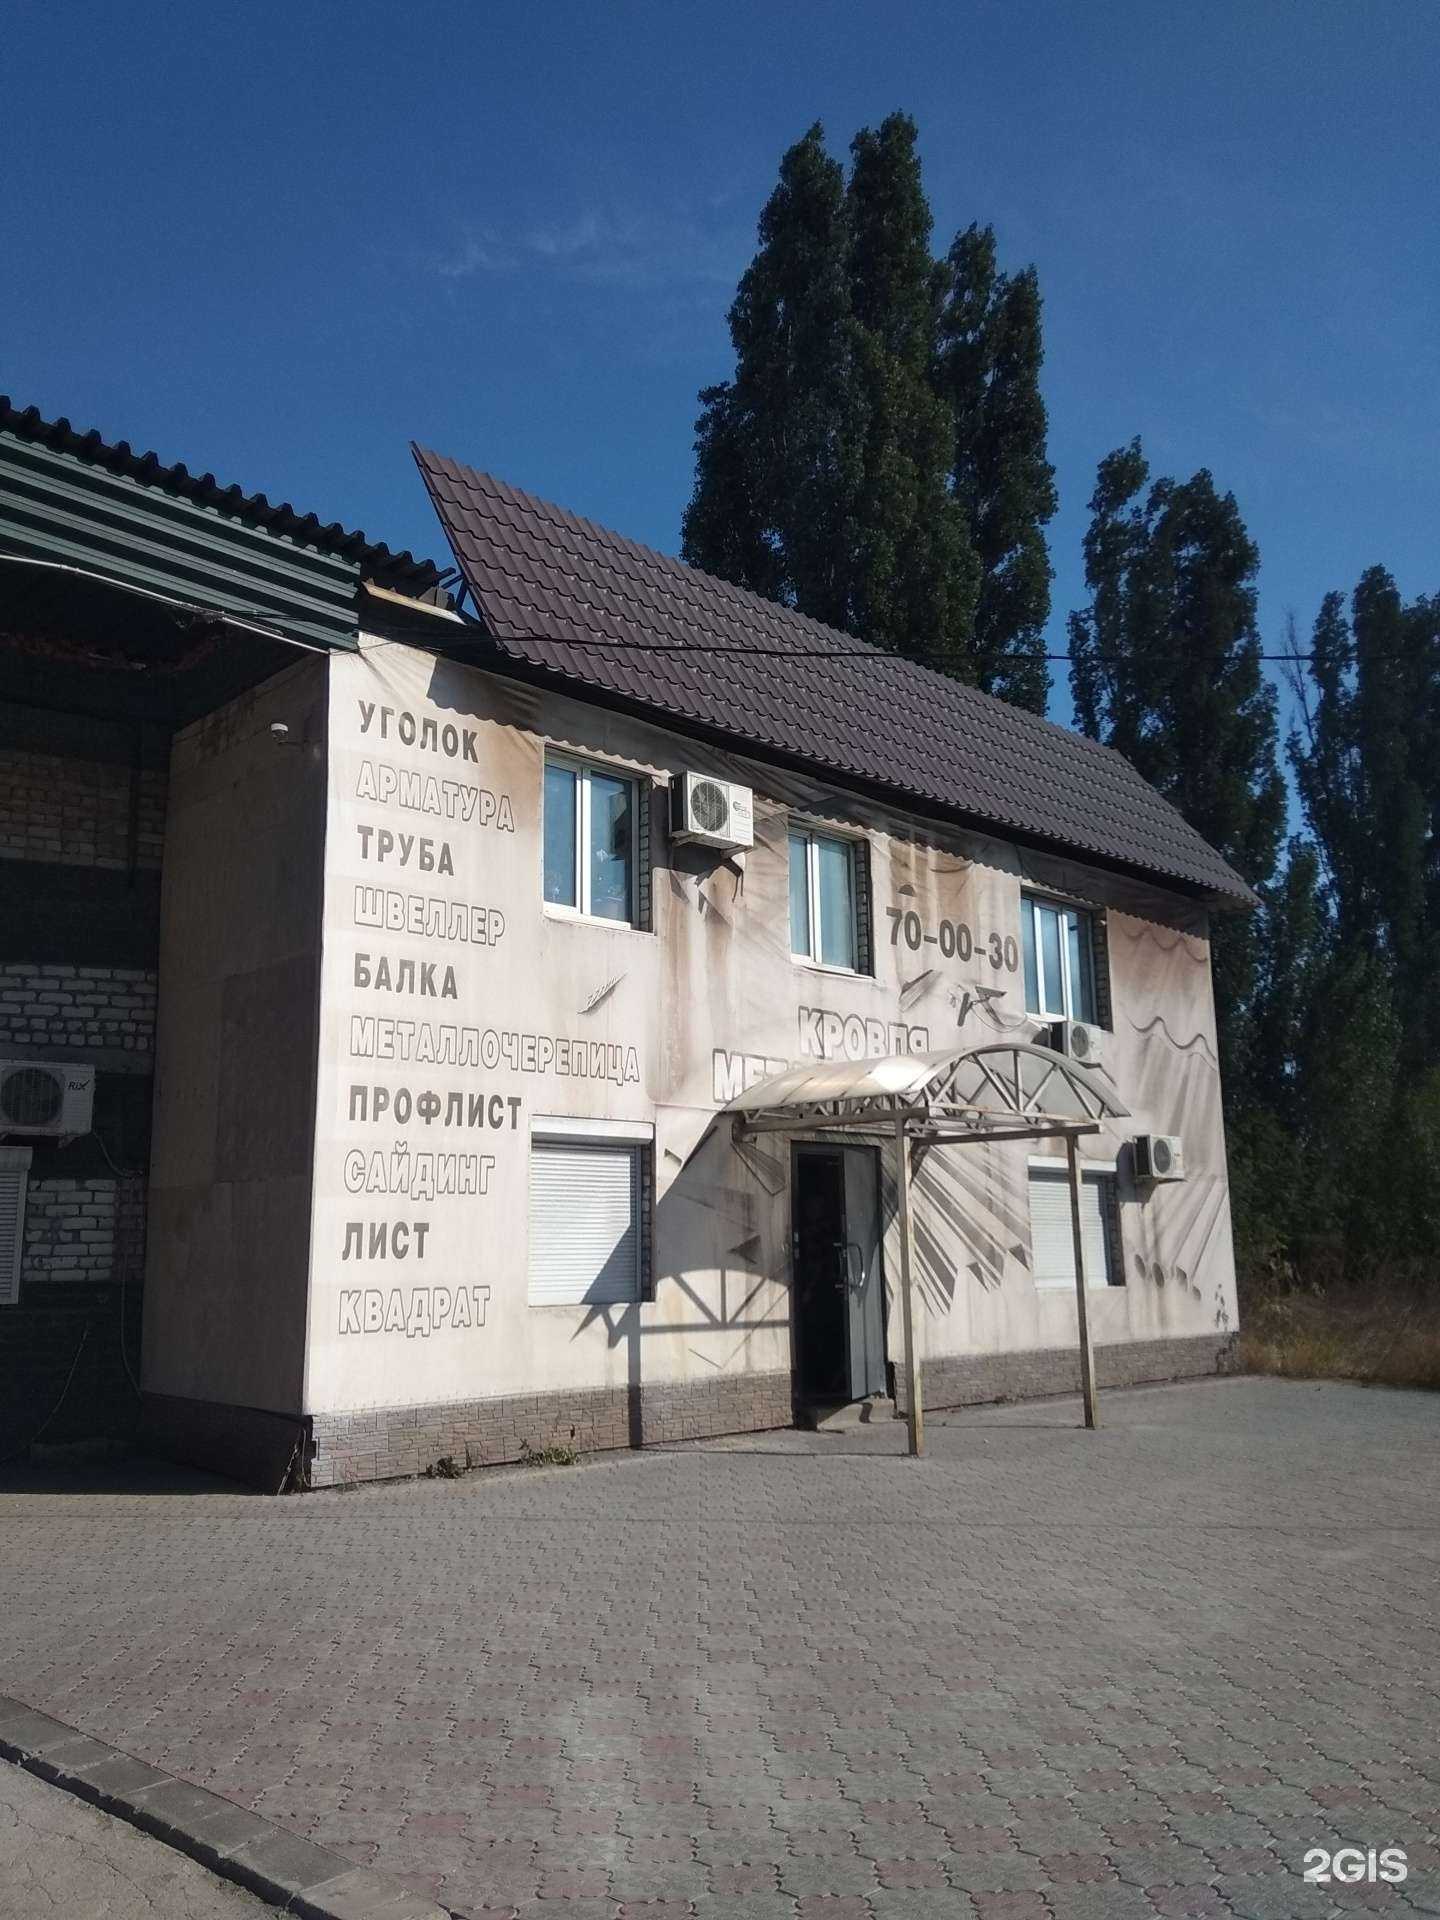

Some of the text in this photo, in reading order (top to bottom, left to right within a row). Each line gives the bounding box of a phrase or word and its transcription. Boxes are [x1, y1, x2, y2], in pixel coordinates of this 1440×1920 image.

[358, 699, 479, 763] УГОЛОК
[356, 760, 515, 833] АРМАТУРА
[357, 824, 454, 876] ТРУБА
[353, 885, 505, 946] ШВЕЛЛЕР
[886, 906, 1018, 973] 70-00-30
[354, 953, 458, 999] БАЛКА
[350, 1015, 640, 1086] МЕТАЛЛОЧЕРЕПИЦА
[349, 1084, 522, 1130] ПРОФЛИСТ
[344, 1141, 496, 1200] САЙДИНГ
[342, 1222, 430, 1260] ЛИСТ
[338, 1285, 491, 1338] КВАДРАТ
